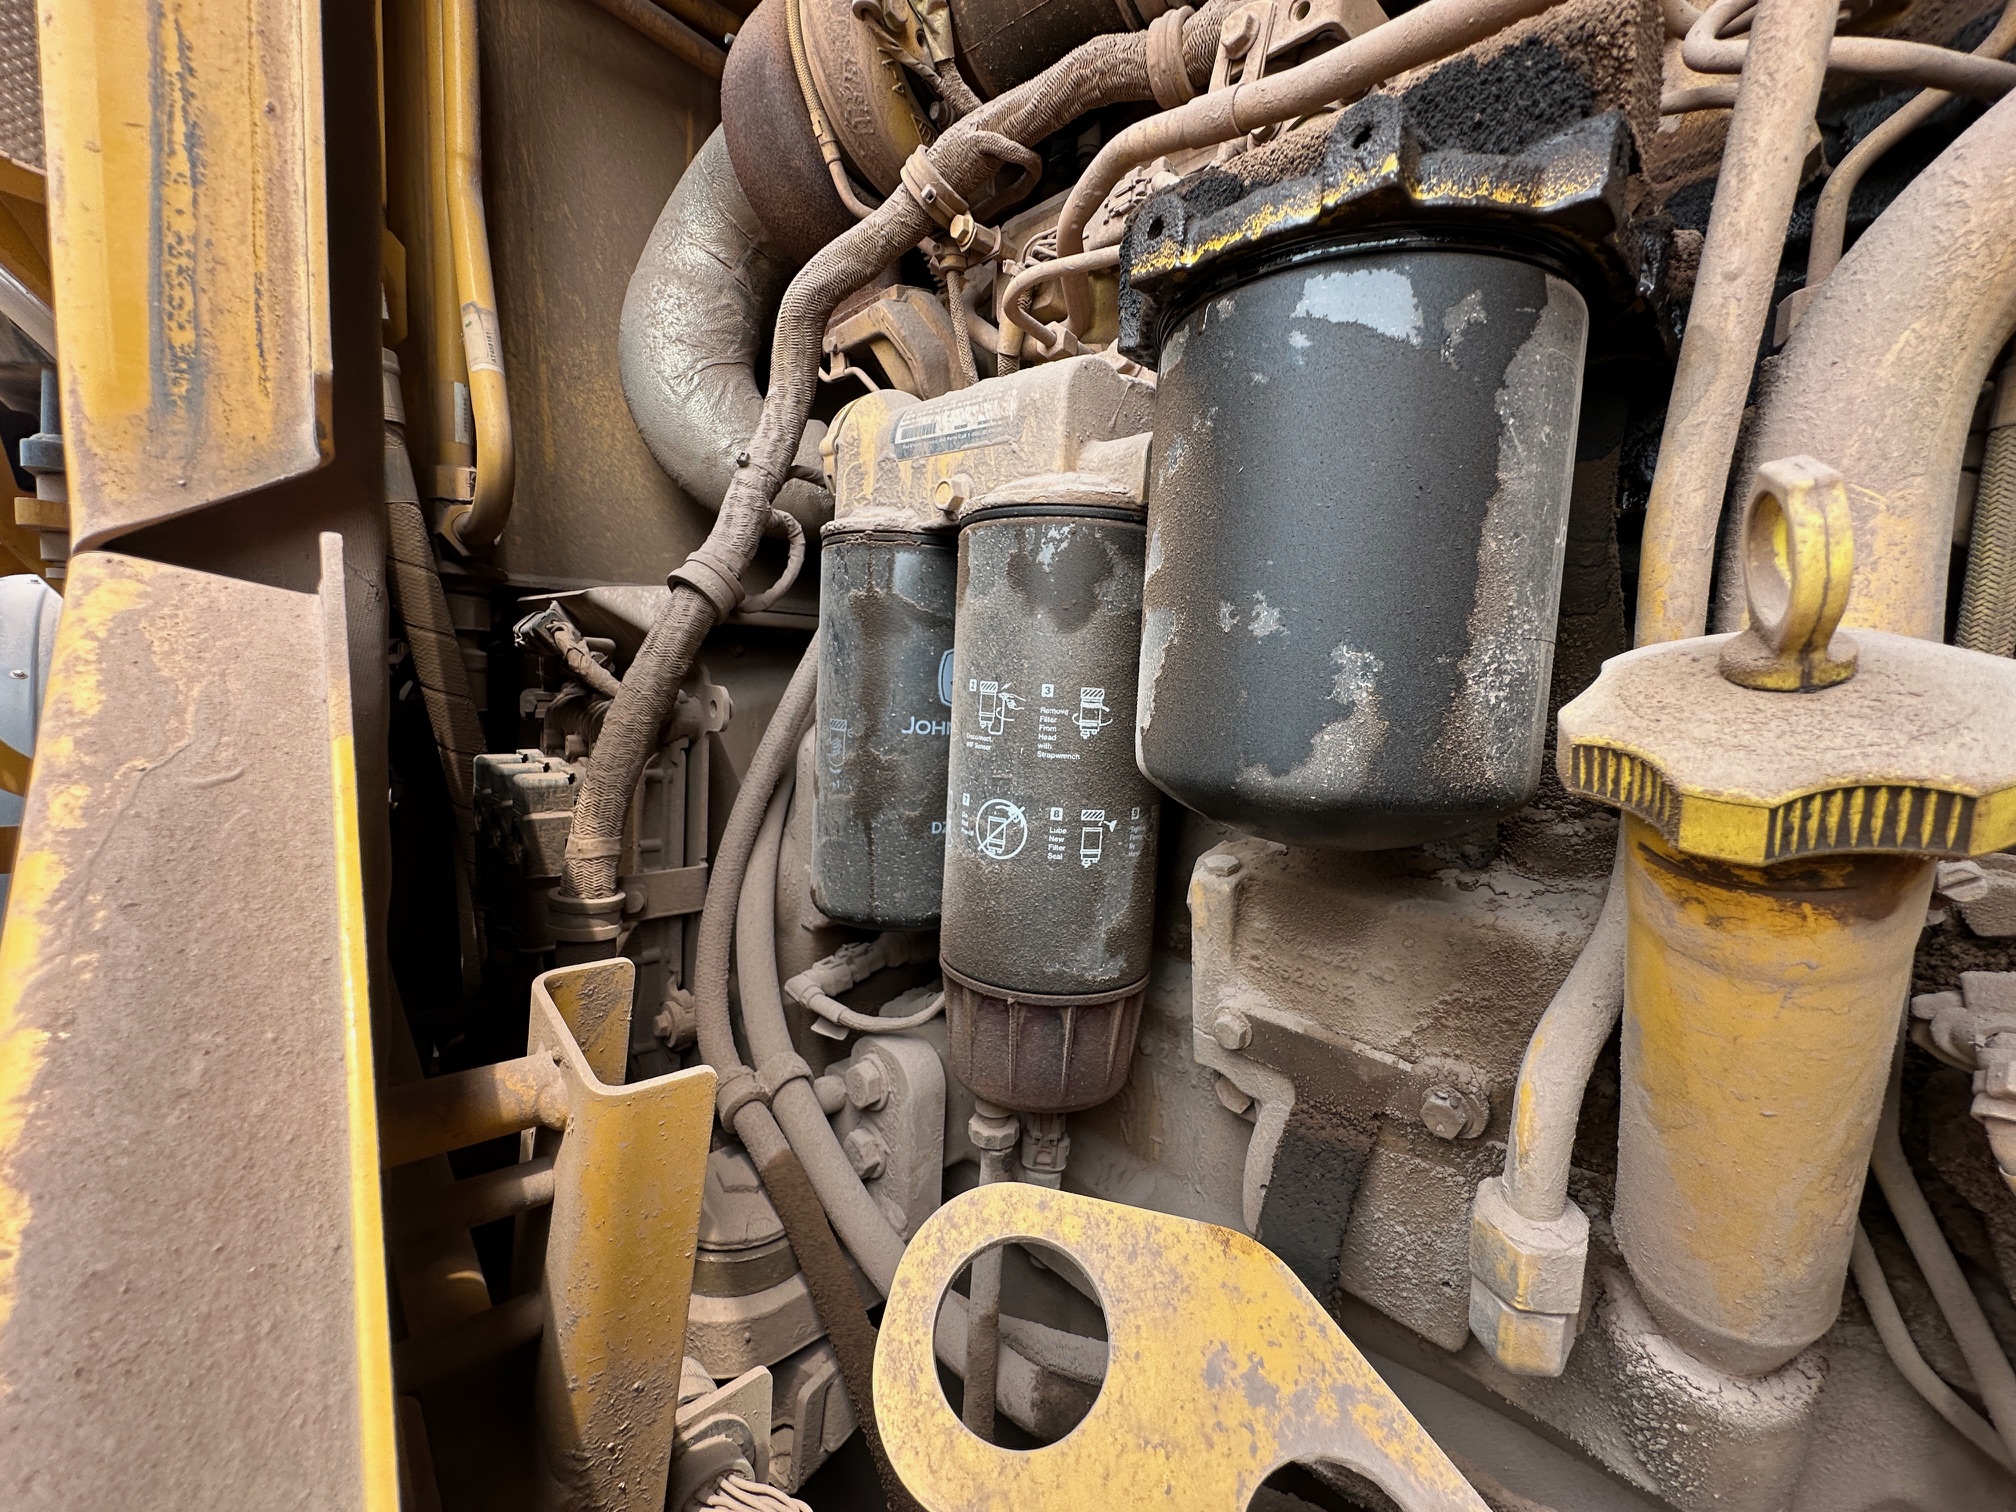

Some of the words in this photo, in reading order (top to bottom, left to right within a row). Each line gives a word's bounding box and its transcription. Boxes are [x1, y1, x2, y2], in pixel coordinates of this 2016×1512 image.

[1040, 706, 1069, 716] Remove
[1039, 715, 1057, 723] Filter
[1039, 724, 1057, 732] From
[1038, 733, 1057, 741] Head
[1037, 742, 1052, 750] with
[1037, 750, 1080, 761] Strapwrench
[1049, 826, 1067, 834] Lube
[1048, 835, 1065, 843] New
[1048, 843, 1066, 852] Filter
[1047, 852, 1063, 860] Seal
